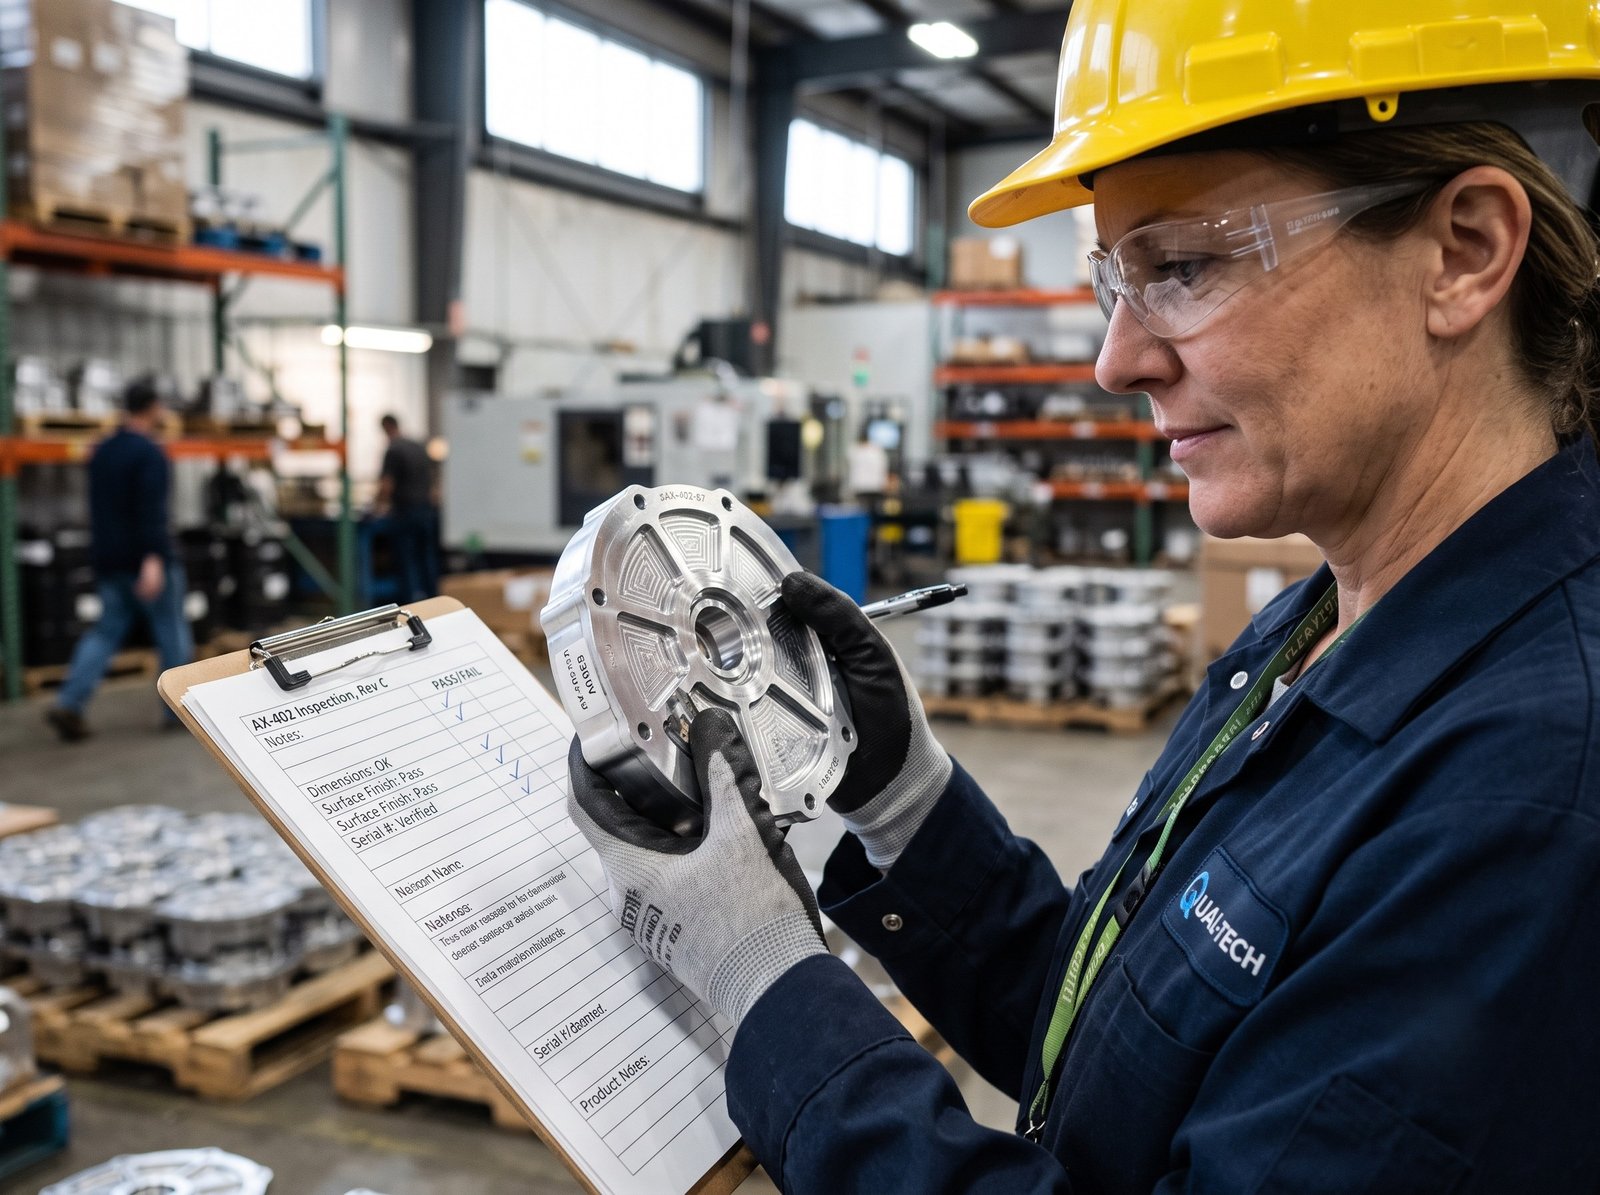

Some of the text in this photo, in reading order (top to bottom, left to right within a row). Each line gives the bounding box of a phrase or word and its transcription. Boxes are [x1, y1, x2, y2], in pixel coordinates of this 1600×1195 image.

[431, 666, 483, 690] PASS/FAIL
[251, 677, 389, 731] AX-402 Inspection, Rev C
[264, 730, 304, 748] Notes:
[306, 757, 393, 798] Dimensions: OK
[321, 767, 424, 815] Surface Finish: Pass
[336, 782, 439, 832] Surface Finish: Pass
[350, 825, 386, 849] Serial
[394, 801, 439, 828] Verified
[533, 1033, 563, 1059] Serial
[579, 1076, 622, 1113] Product
